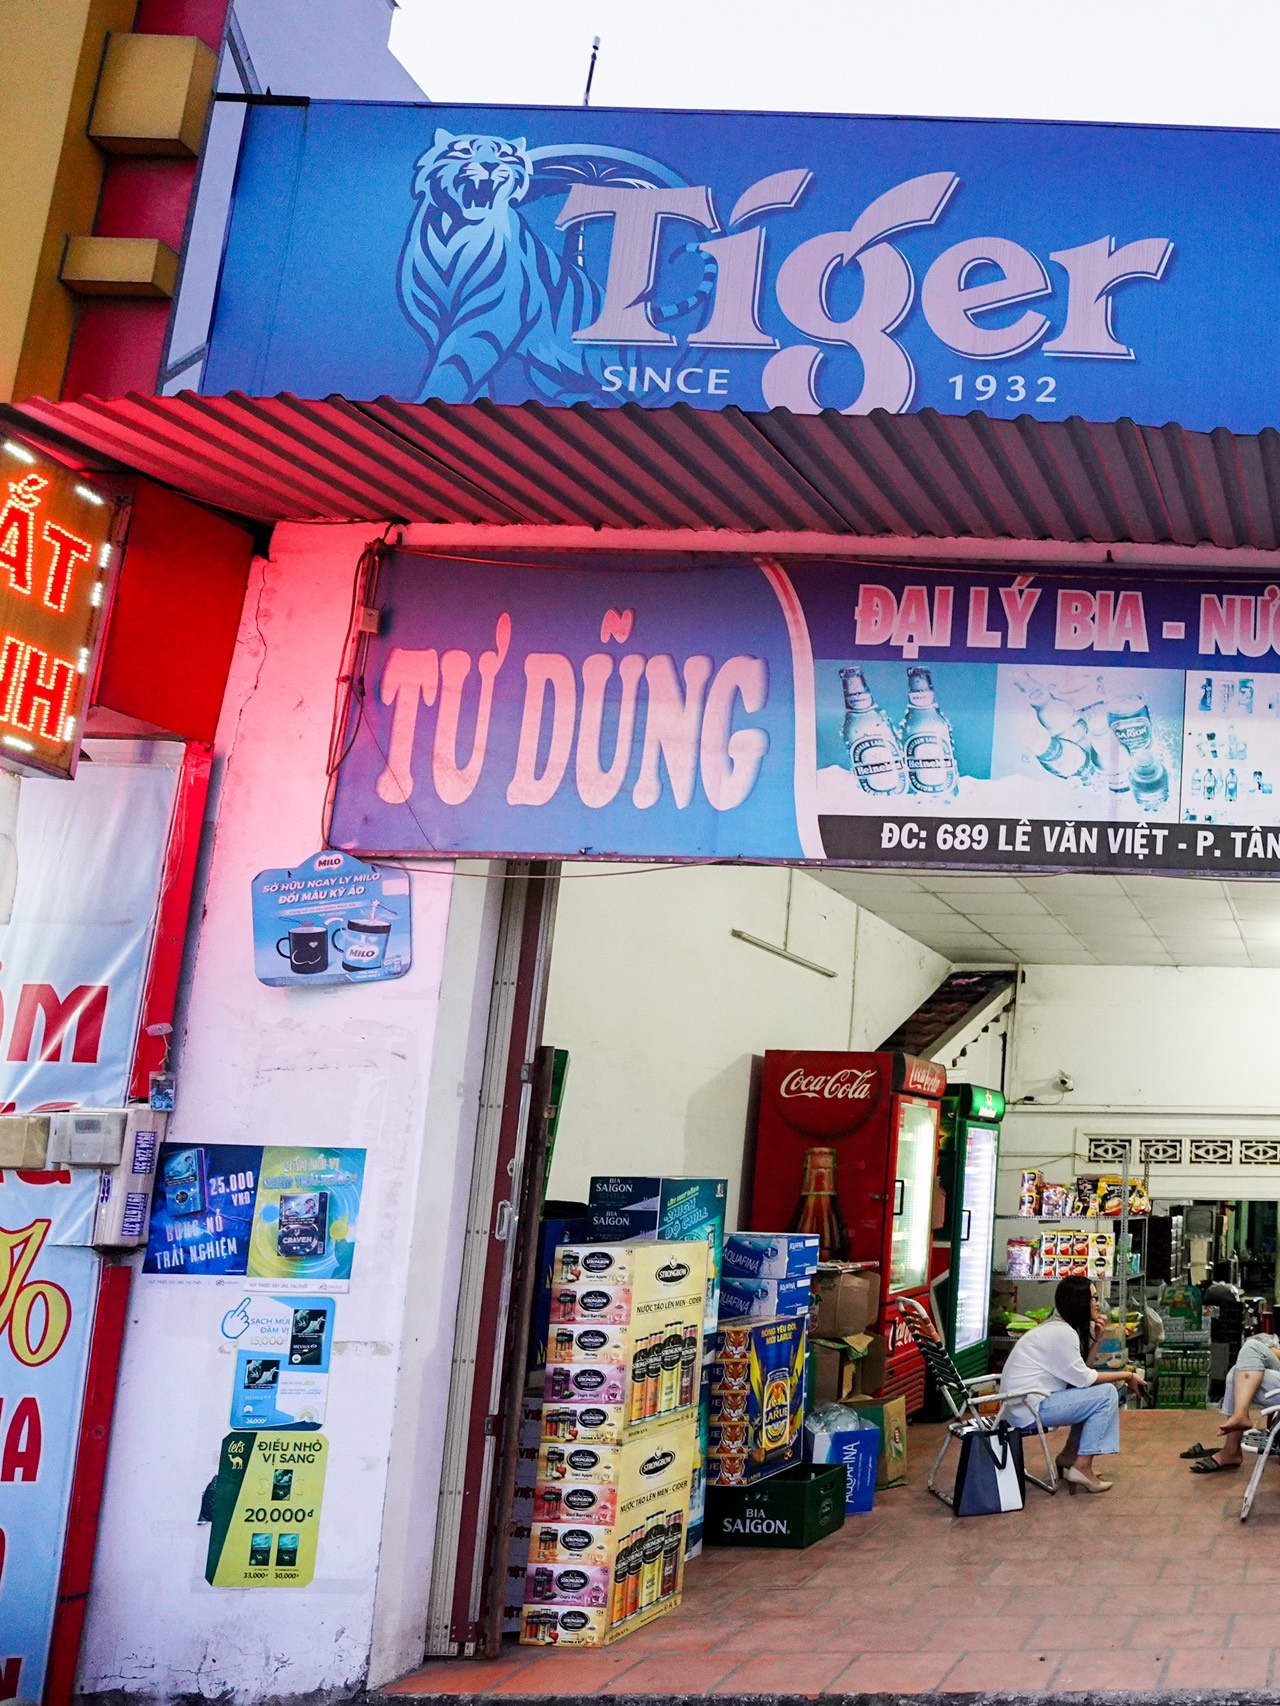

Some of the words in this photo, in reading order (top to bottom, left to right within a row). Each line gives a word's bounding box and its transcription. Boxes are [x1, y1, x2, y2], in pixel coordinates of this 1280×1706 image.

[554, 169, 1175, 414] Tiger
[600, 366, 730, 397] SINCE
[950, 374, 1058, 404] 1932
[854, 584, 952, 659] ĐẠI
[966, 575, 1039, 651] LÝ
[1055, 590, 1150, 654] BIA
[376, 611, 511, 805] TƯ
[506, 606, 771, 810] DŨNG
[880, 824, 927, 851] ĐC:
[936, 824, 988, 852] 689
[998, 817, 1032, 853] LÊ
[1041, 820, 1098, 855] VĂN
[1107, 824, 1169, 860] VIỆT
[1196, 831, 1221, 859] P.
[317, 858, 342, 868] MILO
[307, 876, 338, 889] NGAY
[338, 875, 352, 885] LY
[353, 872, 381, 883] MILO
[348, 948, 375, 959] MILO
[779, 1068, 878, 1099] Coca-Cola
[209, 1170, 255, 1196] 25.000
[595, 1183, 634, 1193] SAIGON
[592, 1216, 631, 1226] SAIGON
[721, 1247, 760, 1274] AQUAFINA
[658, 1268, 687, 1279] STRONGBOW
[764, 1407, 789, 1424] LARUE
[257, 1439, 289, 1452] ĐIẾU
[293, 1439, 322, 1452] NHỎ
[262, 1454, 275, 1465] VỊ
[280, 1453, 315, 1464] SANG
[745, 1509, 766, 1518] BIA
[722, 1519, 788, 1535] SAIGON
